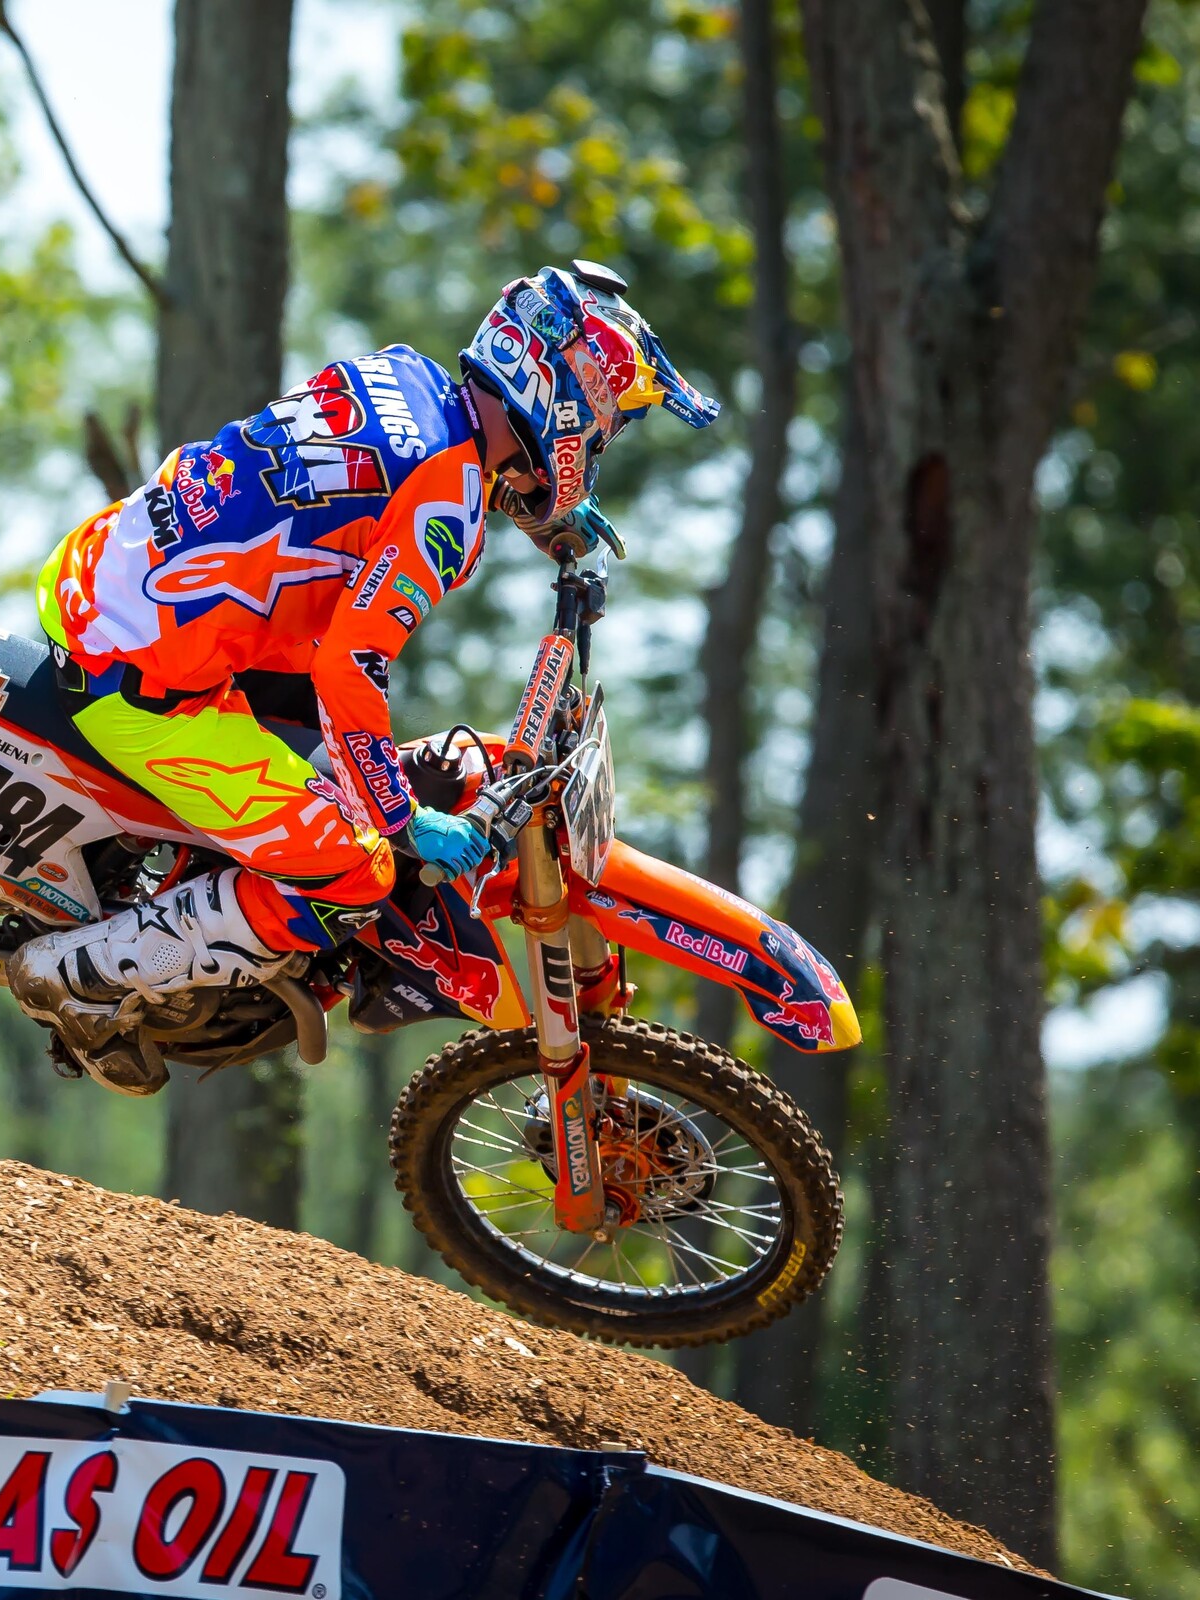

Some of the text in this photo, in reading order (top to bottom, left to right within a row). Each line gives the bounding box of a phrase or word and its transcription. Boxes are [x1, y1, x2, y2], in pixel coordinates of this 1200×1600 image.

[143, 484, 182, 551] KTM
[174, 457, 220, 532] Red Bull
[354, 556, 391, 609] ATHENA
[520, 644, 567, 749] RENTHAL
[346, 732, 387, 777] Red
[368, 771, 407, 814] Bull
[37, 885, 88, 921] MOTOREX
[664, 920, 749, 974] Red Bull
[392, 983, 435, 1013] KTM
[565, 1116, 591, 1193] MOTOREX
[756, 1239, 807, 1309] PIRELLI
[133, 1456, 319, 1595] OIL
